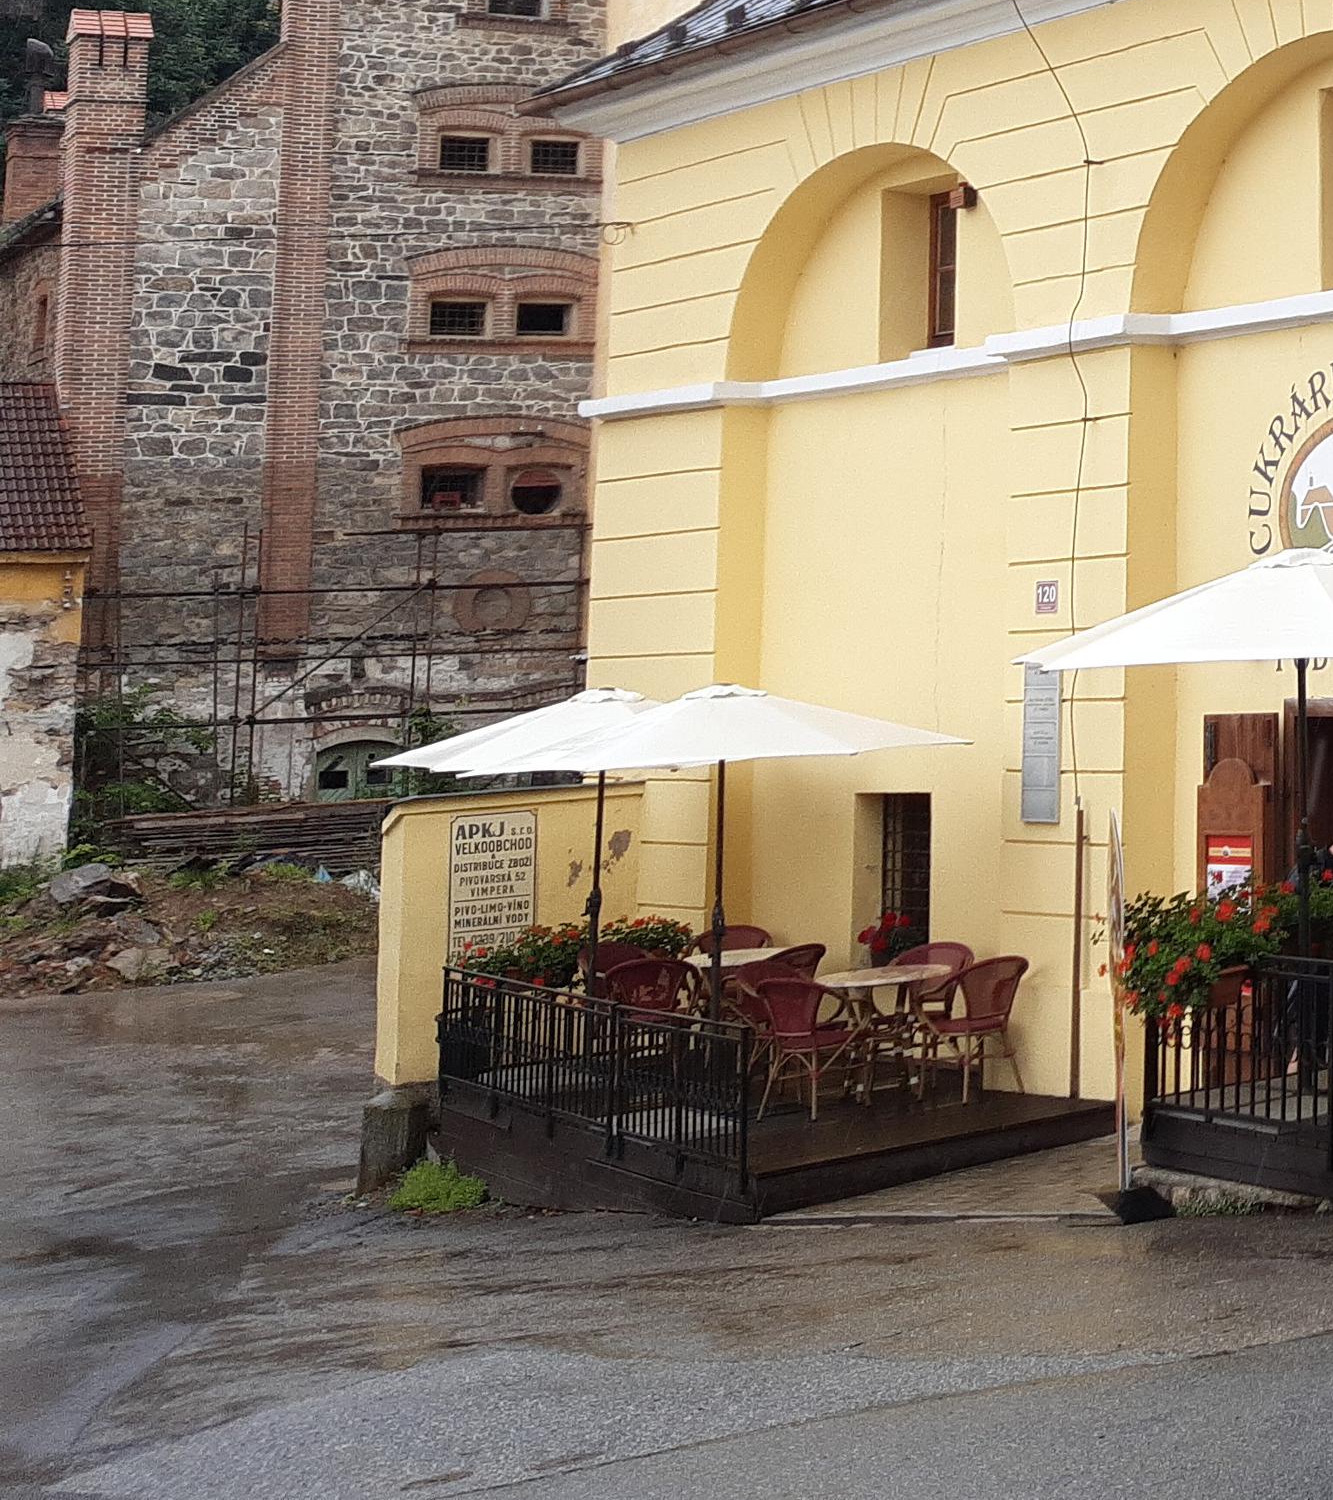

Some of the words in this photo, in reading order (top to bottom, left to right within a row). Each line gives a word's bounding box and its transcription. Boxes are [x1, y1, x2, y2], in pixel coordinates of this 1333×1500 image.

[1037, 585, 1056, 603] 120
[455, 821, 505, 840] APKJ
[455, 837, 532, 855] VELKOOBCHOD
[454, 859, 505, 873] DISTRIBUCE
[460, 871, 511, 887] PIVOVARSKÁ
[470, 884, 515, 897] VIMPERK
[454, 899, 530, 917] PIVO-LIMO-VÍNO
[454, 913, 502, 929] MINERÁLNÍ
[505, 912, 529, 924] VODY
